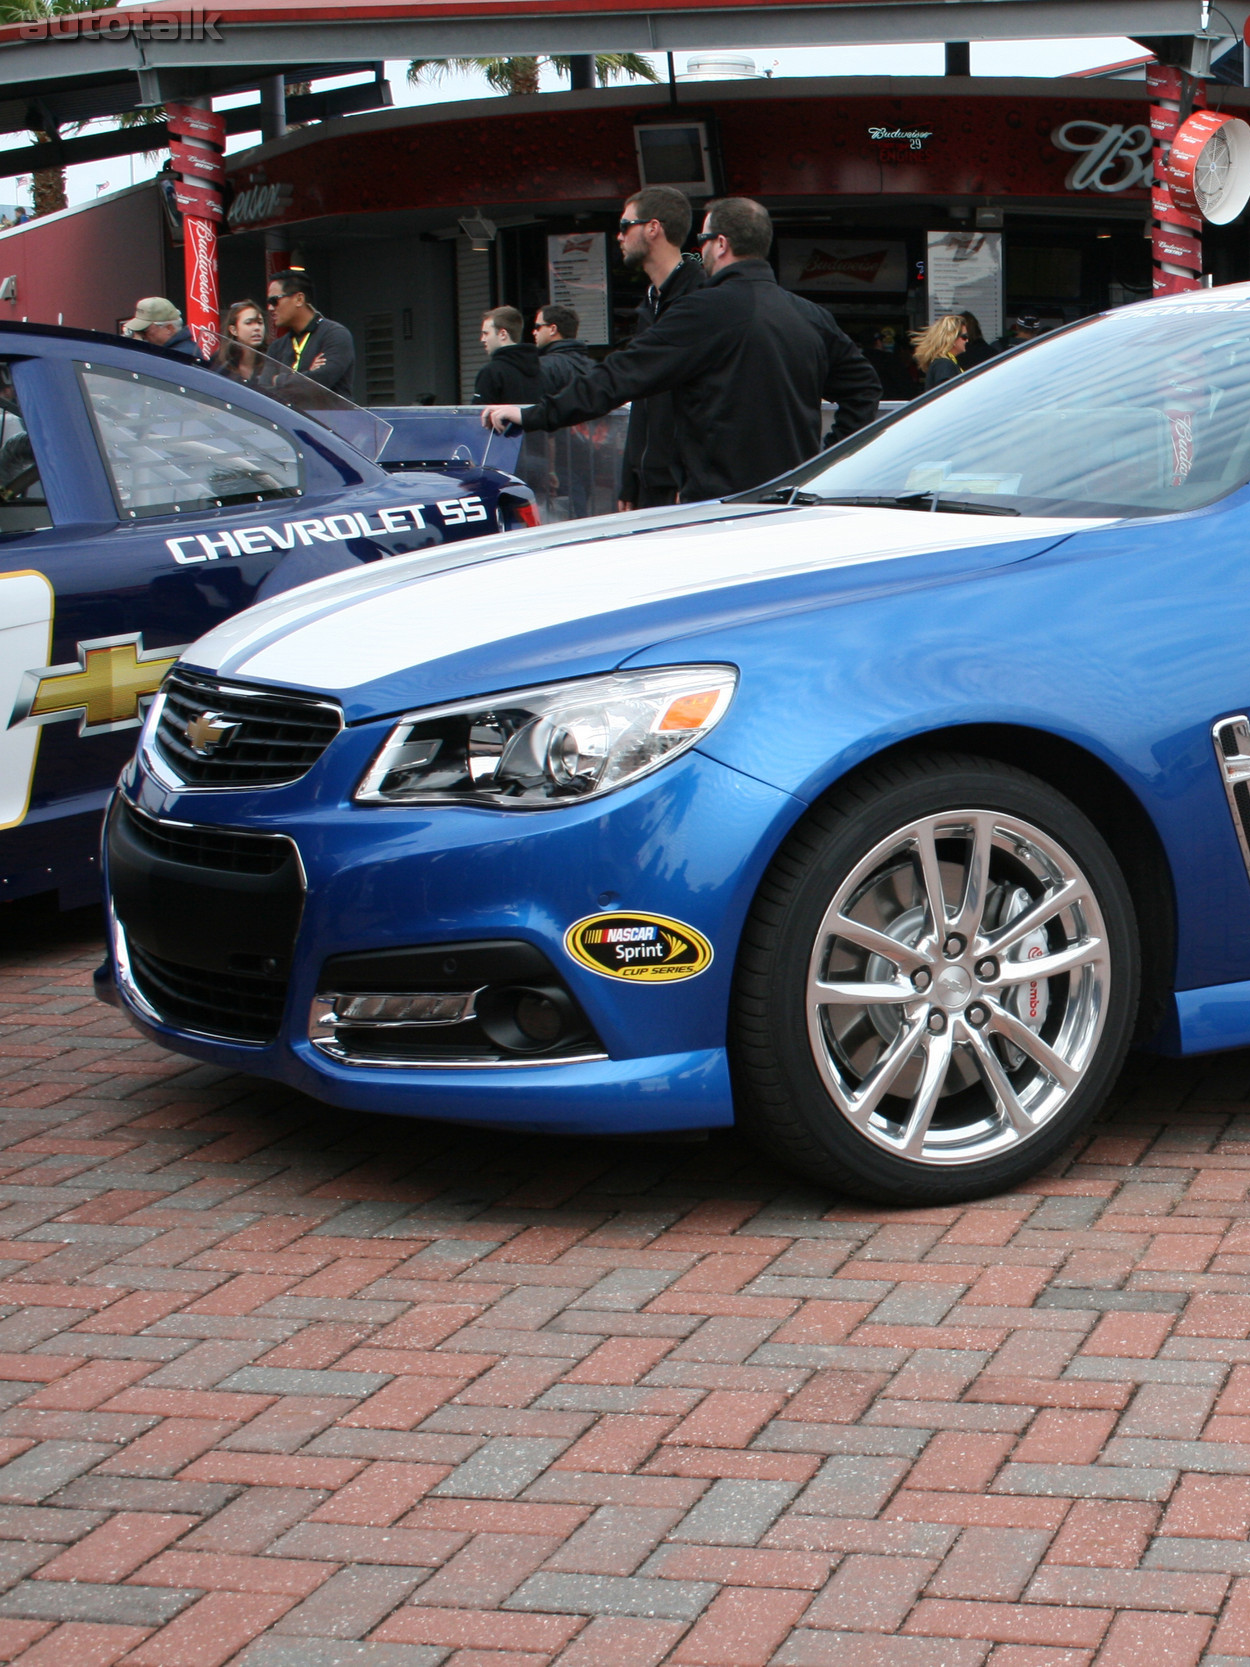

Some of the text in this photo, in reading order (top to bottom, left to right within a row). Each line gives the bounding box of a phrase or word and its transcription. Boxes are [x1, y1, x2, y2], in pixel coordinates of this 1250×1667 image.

[867, 127, 933, 139] Budweiser
[195, 219, 213, 313] Budweiser
[165, 496, 488, 565] CHEVROLET SS
[606, 926, 655, 943] NASCAR
[615, 942, 664, 963] Sprint
[622, 965, 695, 976] CUP SERIES
[1029, 980, 1040, 1018] embo
